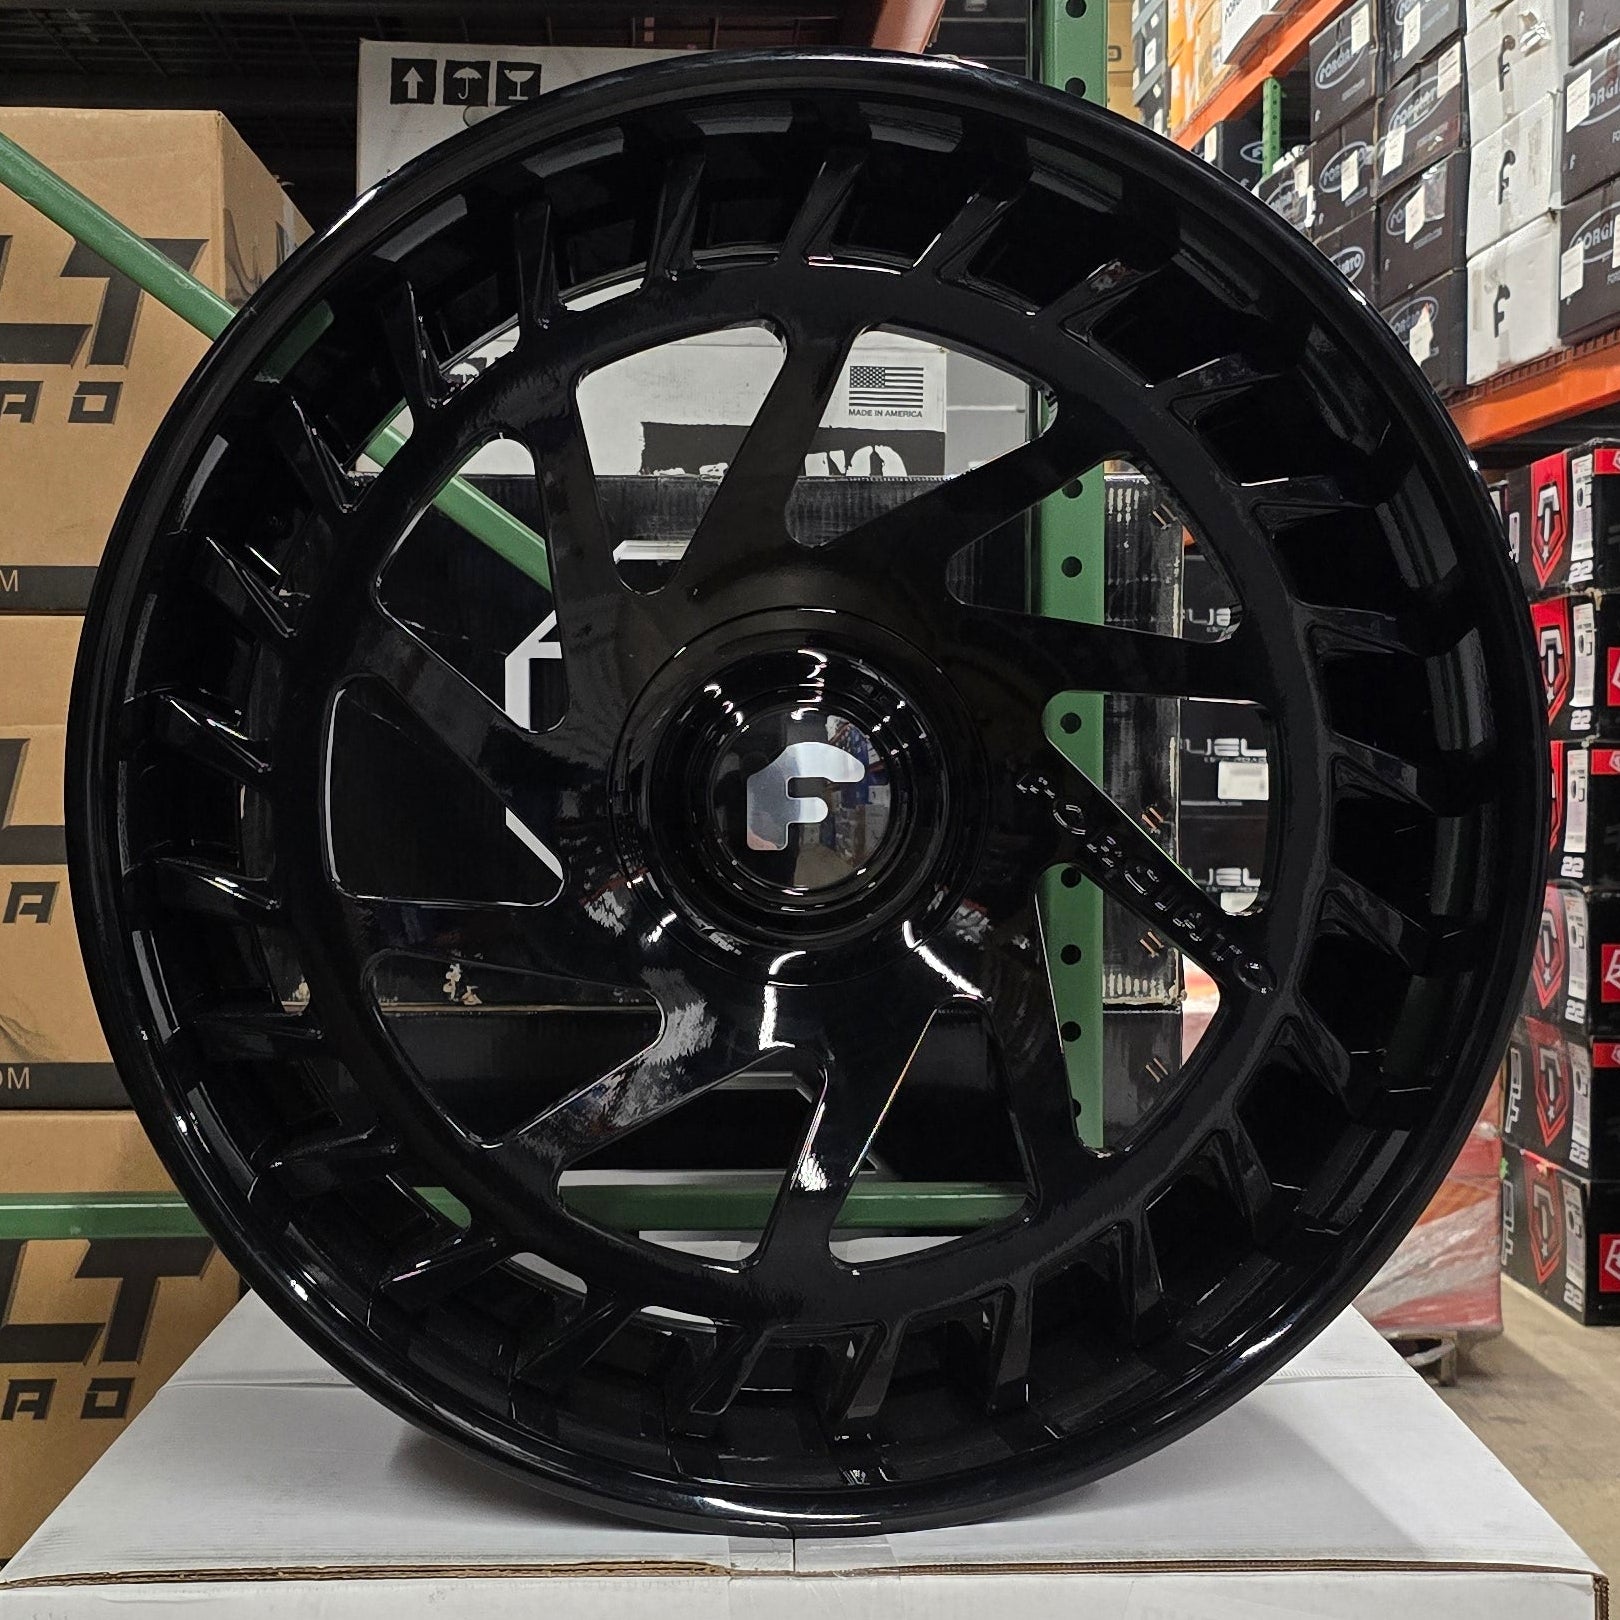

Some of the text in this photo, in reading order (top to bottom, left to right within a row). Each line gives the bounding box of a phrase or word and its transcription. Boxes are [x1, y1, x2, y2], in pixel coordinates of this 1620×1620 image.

[849, 409, 873, 417] MADE
[885, 410, 923, 418] AMERICA
[1180, 738, 1267, 757] UEL
[1187, 867, 1261, 887] UEL
[0, 1066, 30, 1090] M
